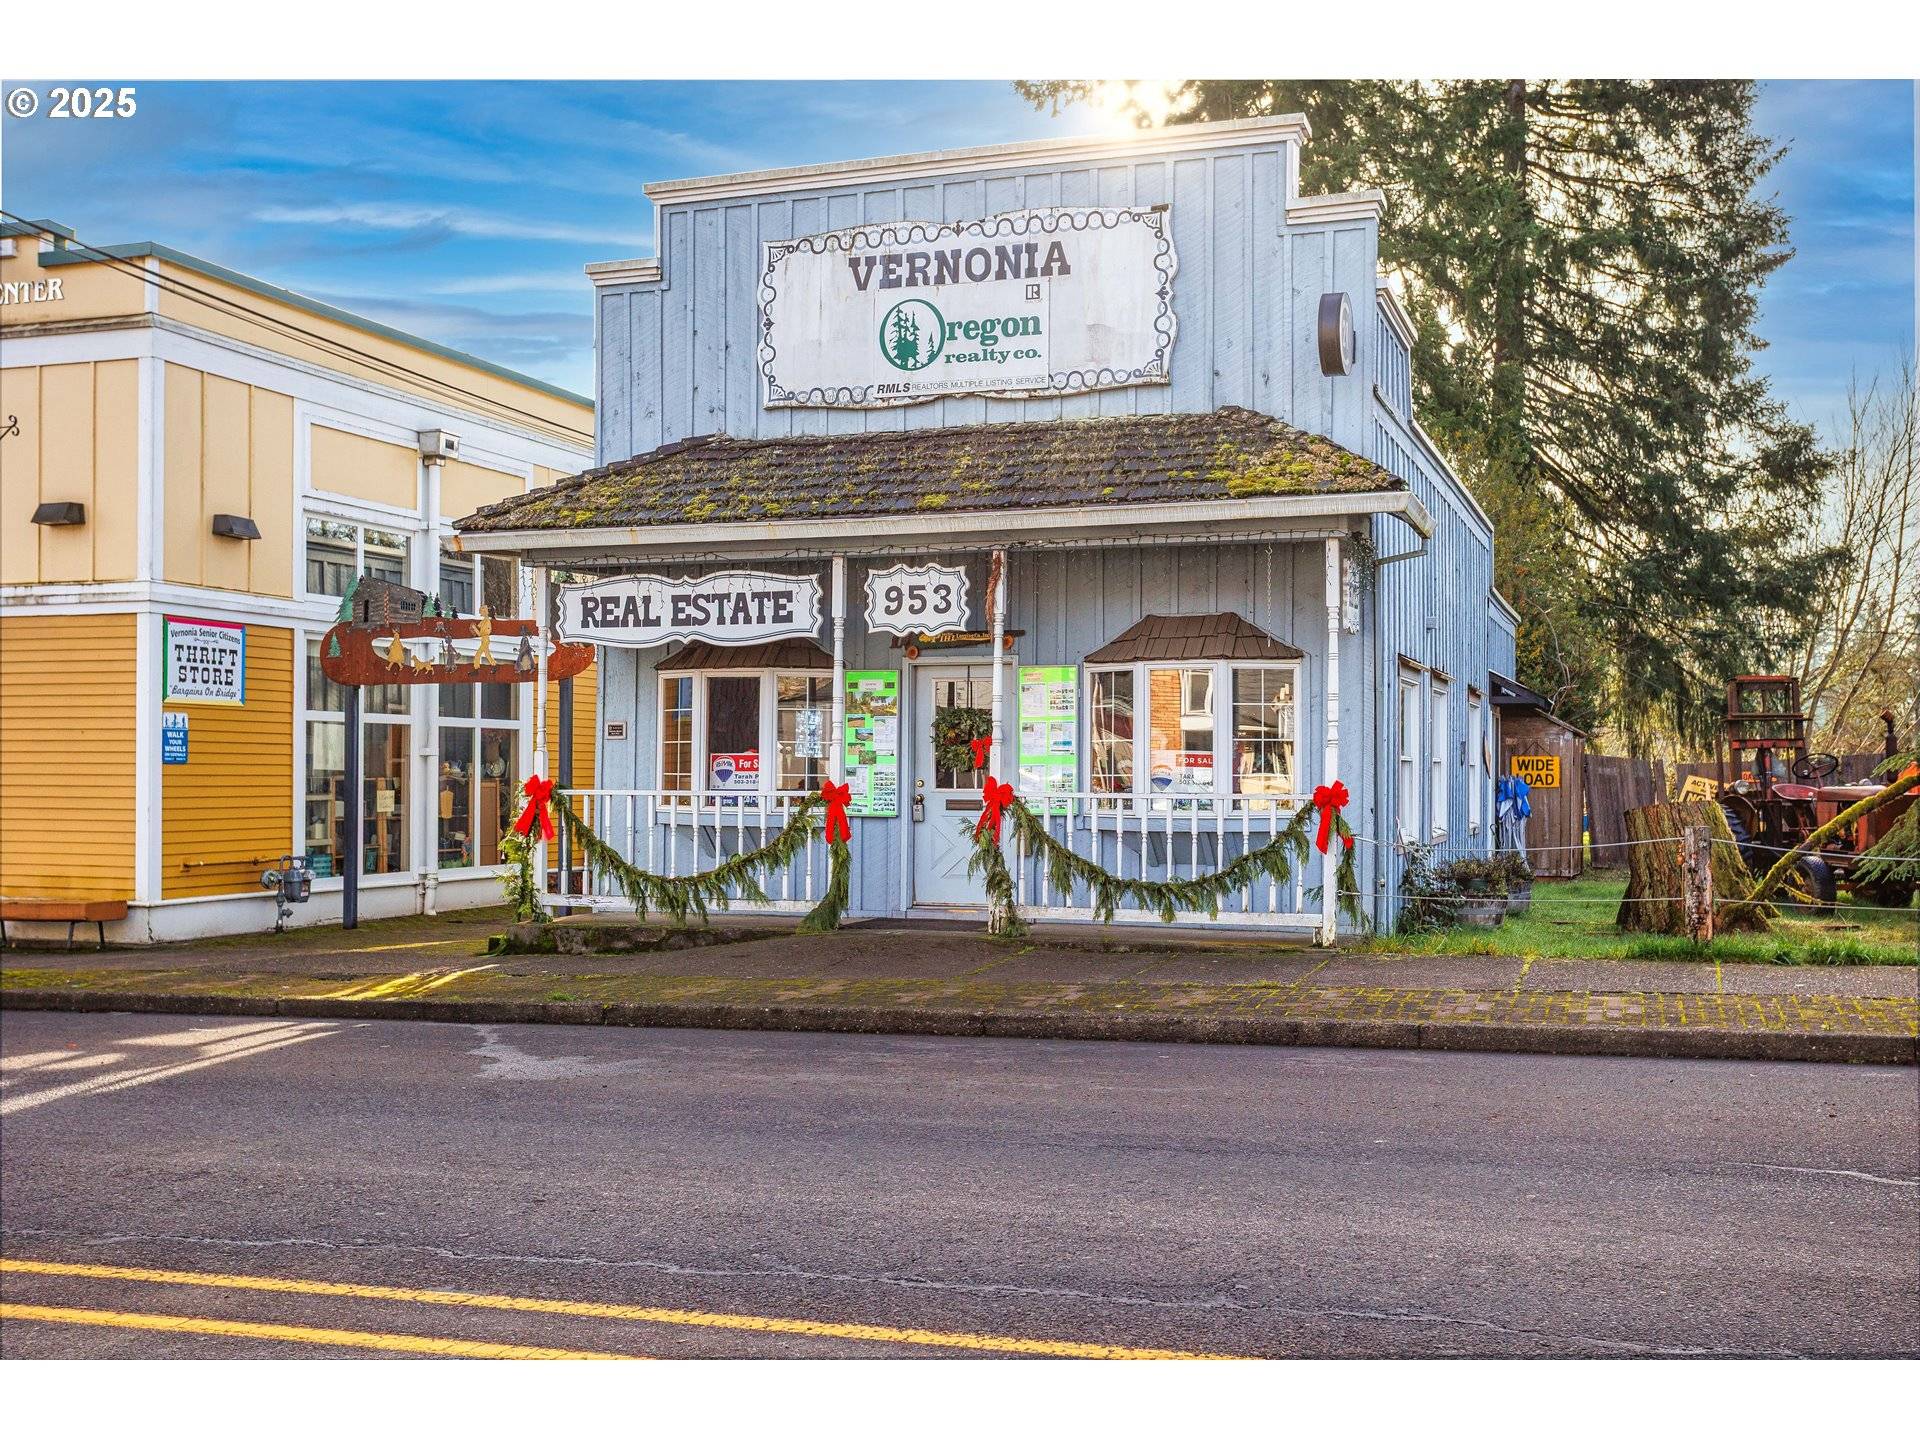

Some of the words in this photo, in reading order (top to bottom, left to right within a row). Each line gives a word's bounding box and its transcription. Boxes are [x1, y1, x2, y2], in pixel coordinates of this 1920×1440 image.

[848, 240, 1071, 291] VERNONIA
[944, 348, 1011, 364] realty
[1013, 348, 1042, 360] co.
[877, 382, 911, 394] RMLS
[951, 380, 983, 389] MULTIPLE
[986, 378, 1013, 387] LISTING
[1015, 376, 1047, 385] SERVICE
[884, 584, 952, 615] 953
[580, 595, 661, 628] REAL
[671, 590, 793, 627] ESTATE
[171, 628, 197, 638] Vernonia
[199, 628, 218, 638] Senior
[219, 631, 241, 644] Citizens
[175, 644, 238, 666] THRIFT
[179, 665, 234, 686] STORE
[205, 687, 213, 697] On
[739, 759, 751, 768] For
[1516, 758, 1554, 772] WIDE
[1516, 773, 1554, 785] OAD
